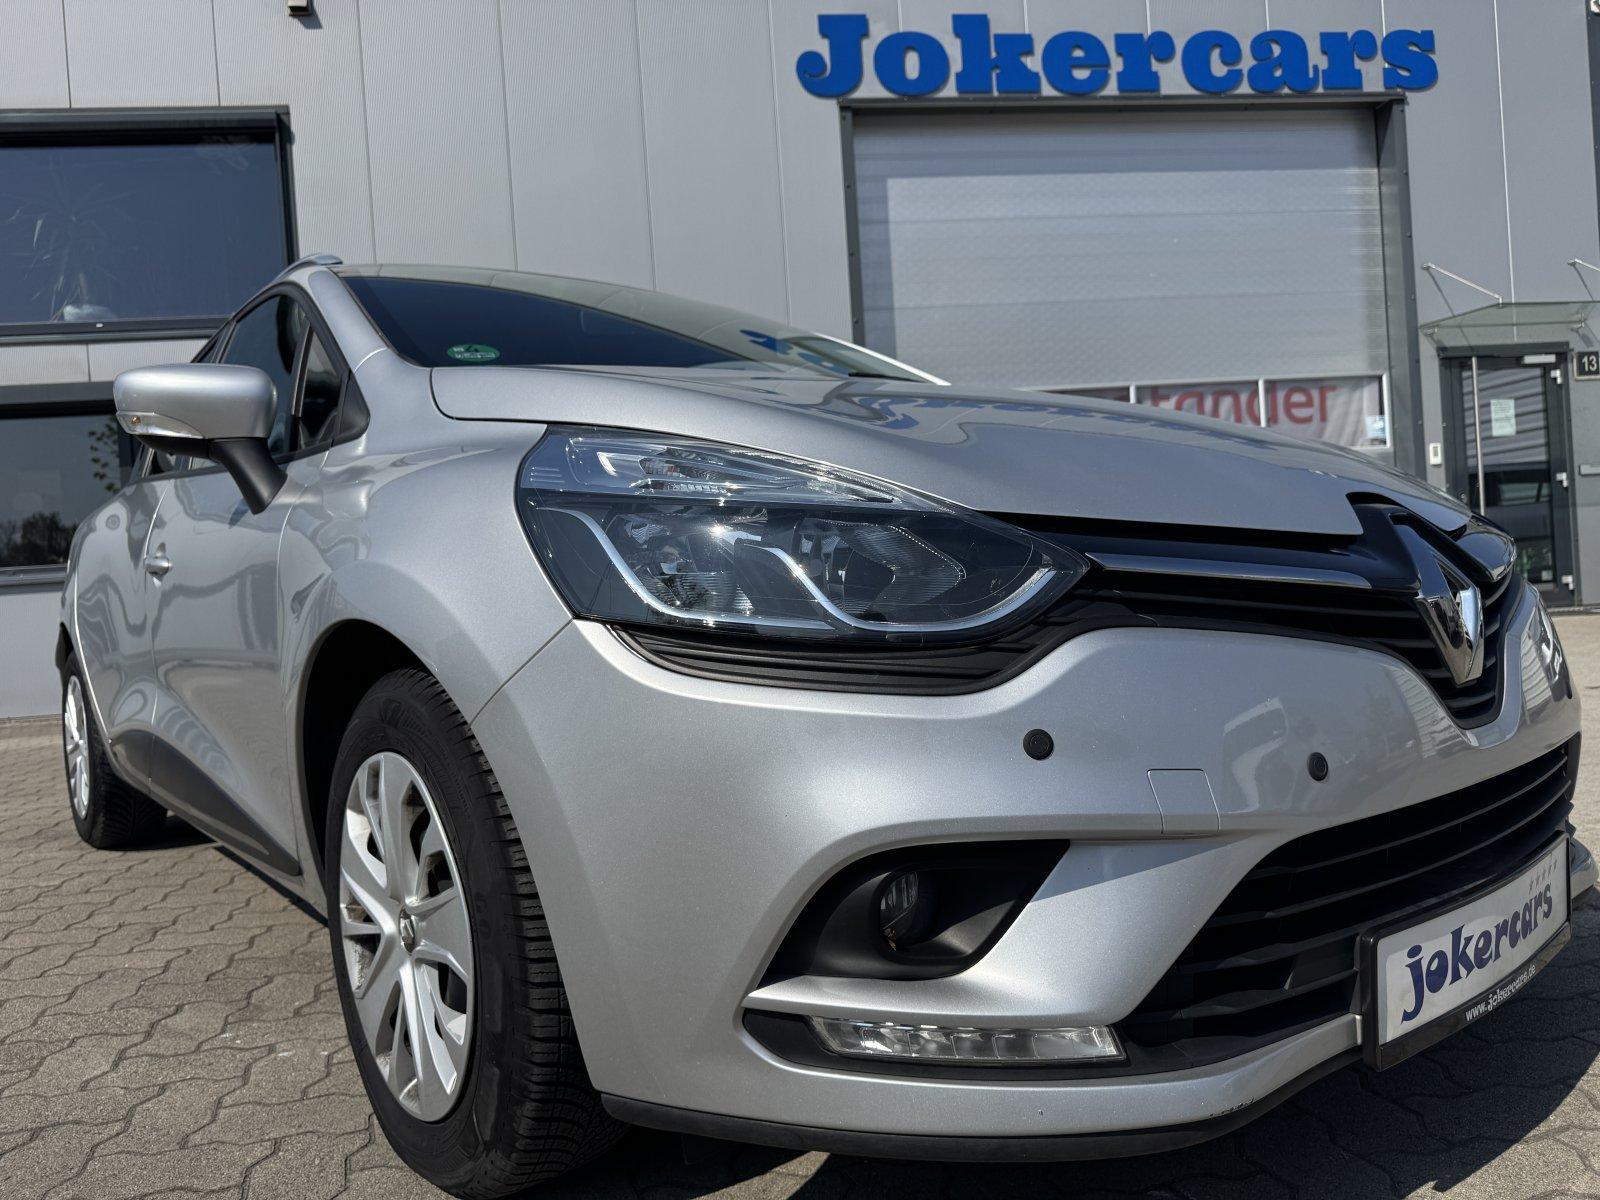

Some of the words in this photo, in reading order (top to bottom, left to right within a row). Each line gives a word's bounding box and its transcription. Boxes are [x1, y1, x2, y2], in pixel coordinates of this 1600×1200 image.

[796, 13, 1438, 98] Jokercars
[1582, 355, 1597, 372] 13
[1117, 383, 1338, 426] tander
[1401, 882, 1553, 1024] jokercars
[1465, 963, 1536, 1022] www.jokercars.de
